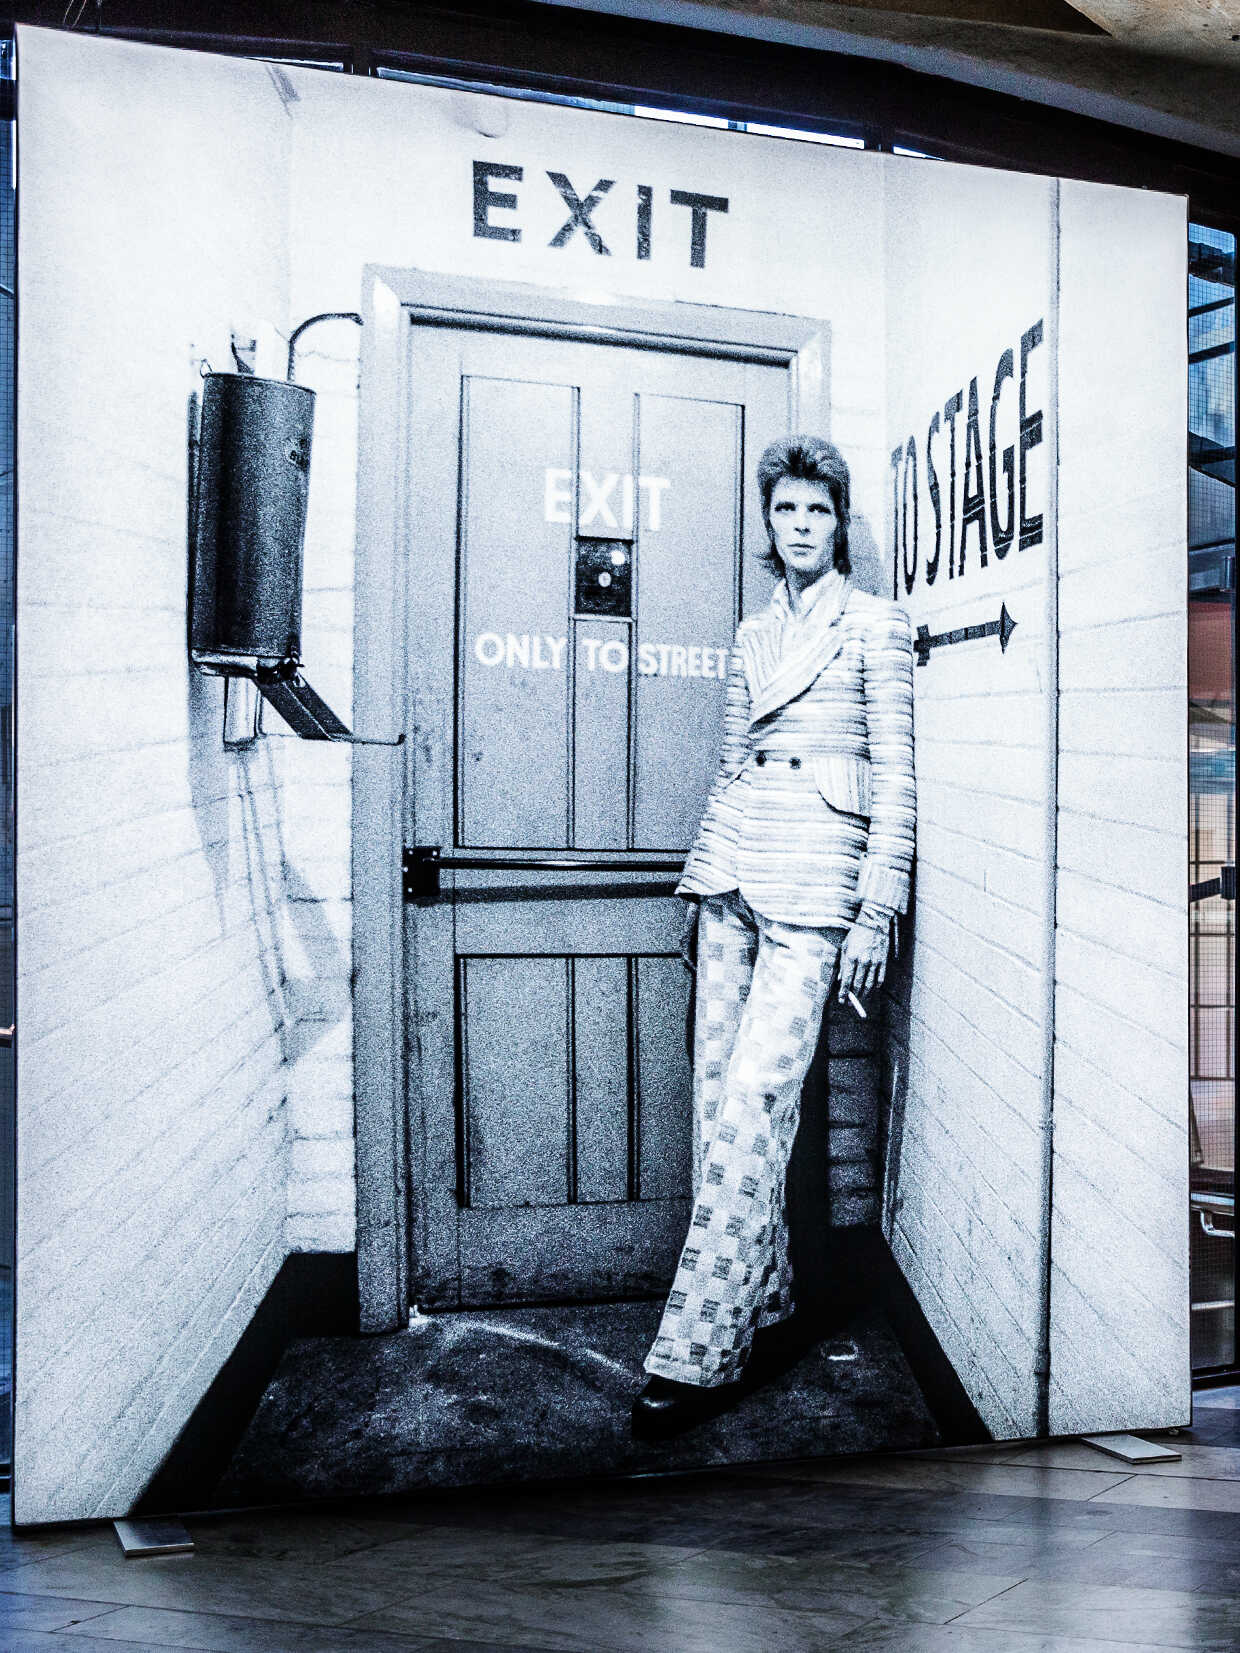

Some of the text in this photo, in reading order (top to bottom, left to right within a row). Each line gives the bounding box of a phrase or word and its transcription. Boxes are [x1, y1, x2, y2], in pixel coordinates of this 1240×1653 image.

[472, 160, 729, 269] EXIT
[544, 468, 671, 532] EXIT
[891, 319, 1044, 601] TO STAGE
[474, 632, 729, 679] ONLY TO STREET
